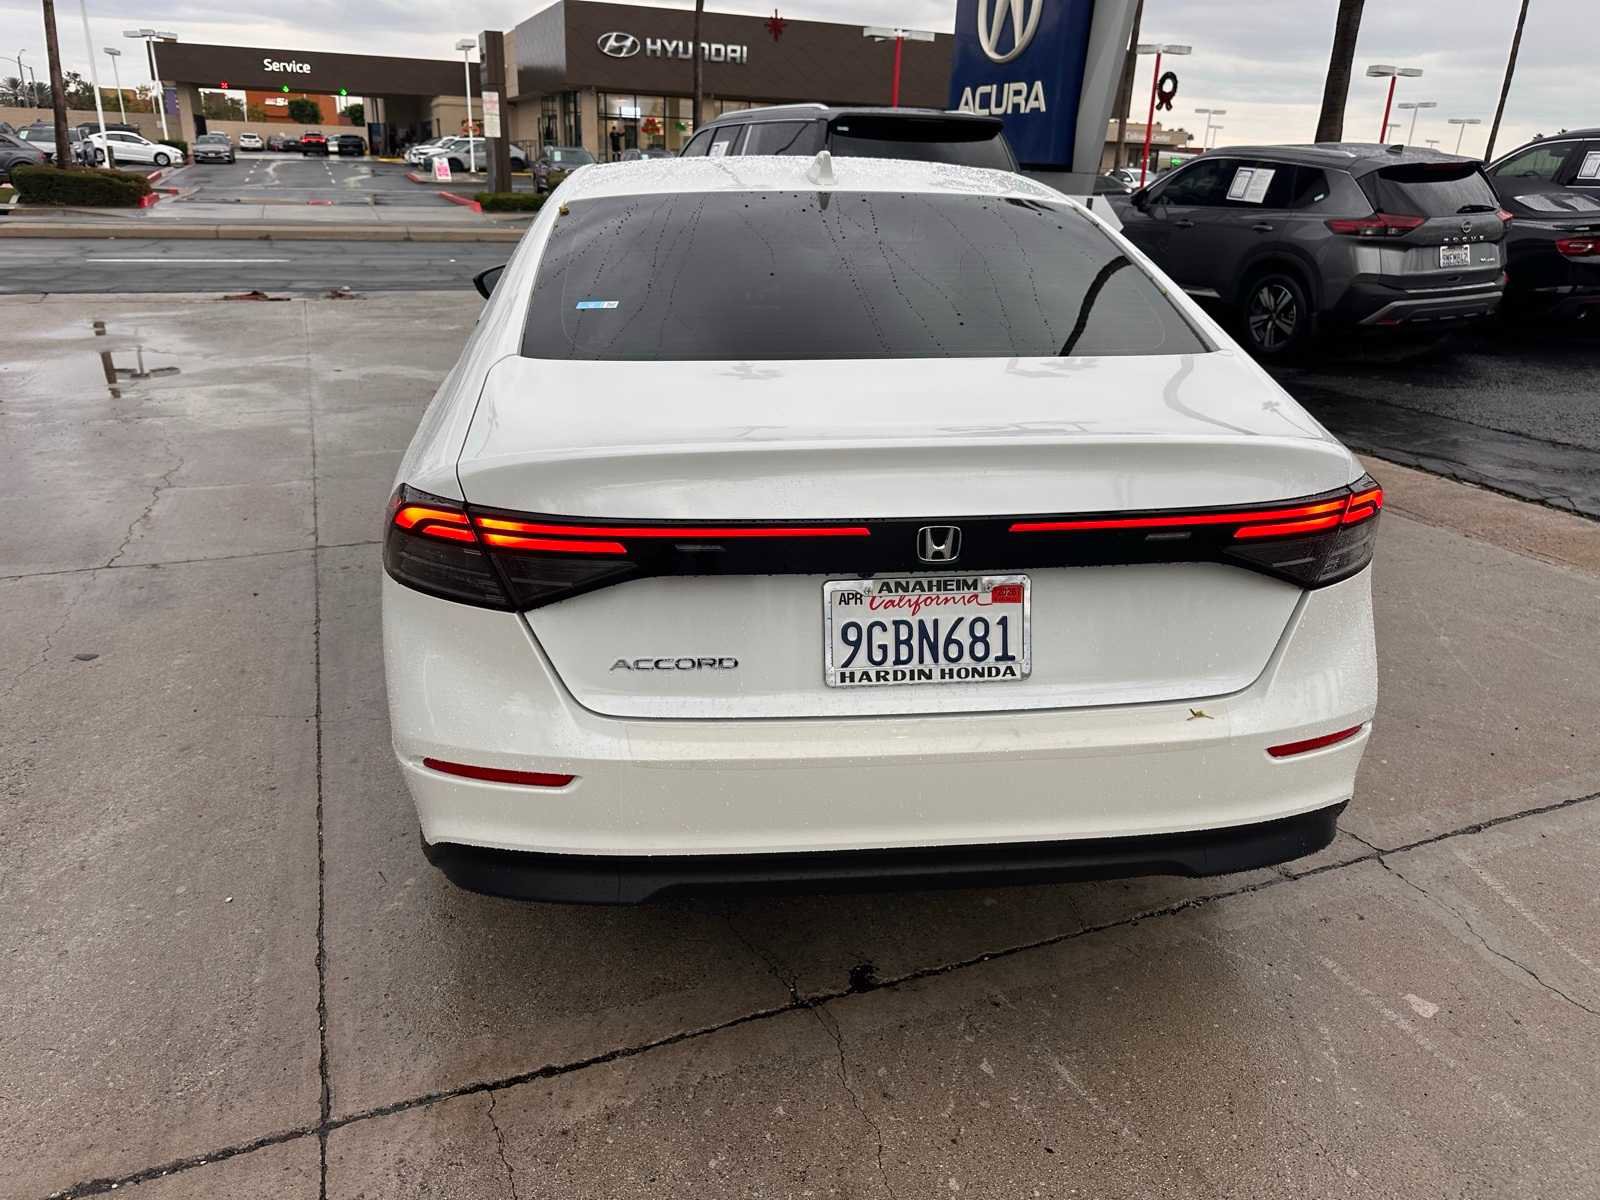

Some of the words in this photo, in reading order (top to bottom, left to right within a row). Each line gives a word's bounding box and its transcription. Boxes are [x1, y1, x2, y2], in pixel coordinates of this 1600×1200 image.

[263, 58, 311, 74] Service
[958, 80, 1046, 116] ACURA
[878, 578, 979, 595] ANAHEIM
[838, 592, 864, 606] APR
[869, 592, 992, 616] California
[840, 615, 1017, 669] 9GBN681
[608, 657, 740, 672] ACCORD
[839, 667, 934, 684] HARDIN
[939, 665, 1017, 681] HONDA
